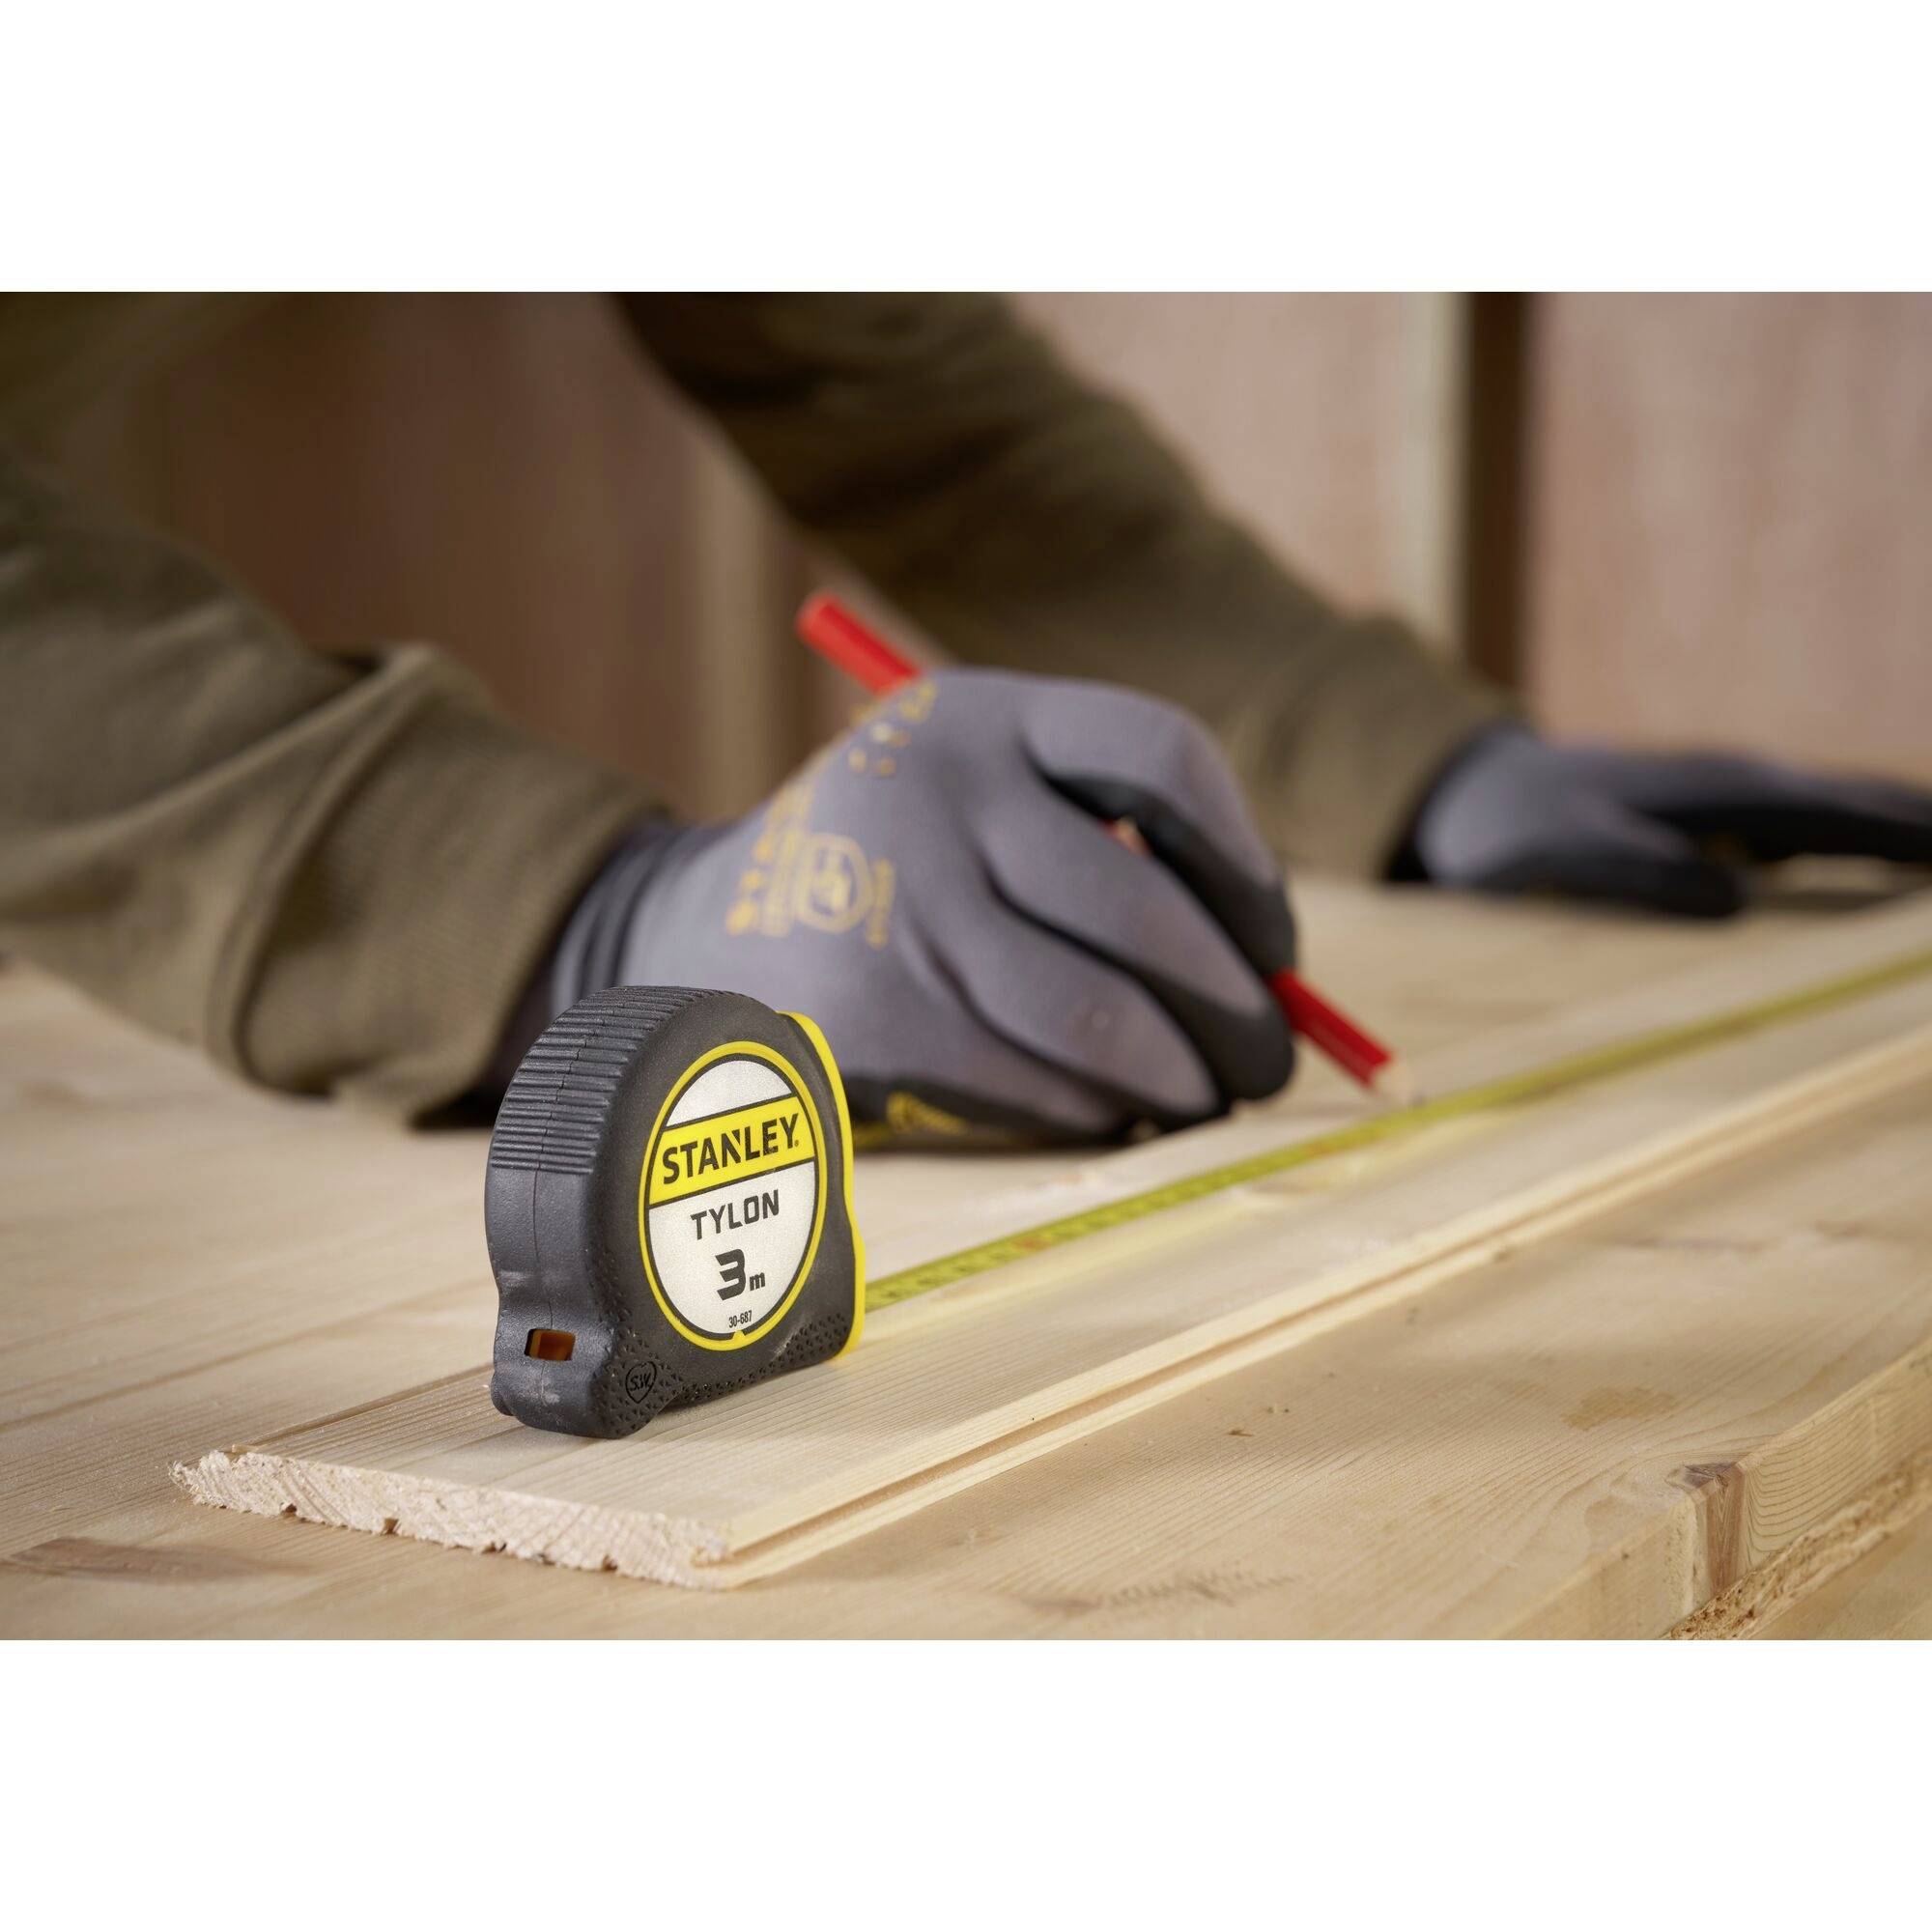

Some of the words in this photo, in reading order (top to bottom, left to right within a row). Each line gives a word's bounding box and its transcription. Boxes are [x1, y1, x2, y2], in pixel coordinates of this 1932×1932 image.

[662, 1113, 800, 1184] STANLEY
[691, 1189, 780, 1240] TYLON
[728, 1310, 753, 1328] 30-687
